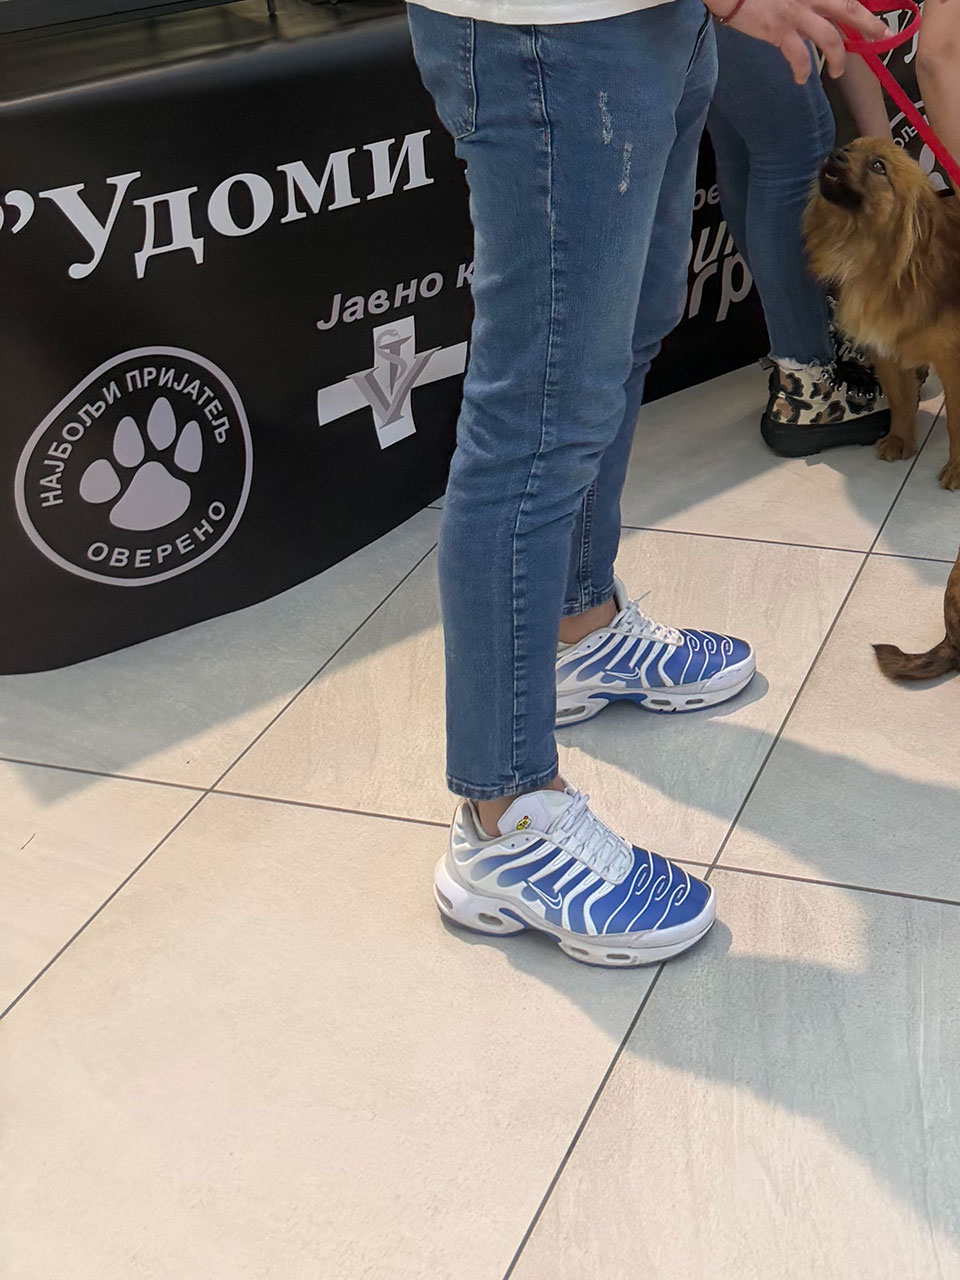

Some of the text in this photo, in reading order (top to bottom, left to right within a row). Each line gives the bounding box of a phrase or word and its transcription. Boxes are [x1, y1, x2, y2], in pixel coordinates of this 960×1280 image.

[316, 272, 444, 331] Јавно
[39, 366, 231, 508] НАЈБОЉИ ПРИЈАТЕЉ
[87, 501, 226, 568] ОВЕРЕНО
